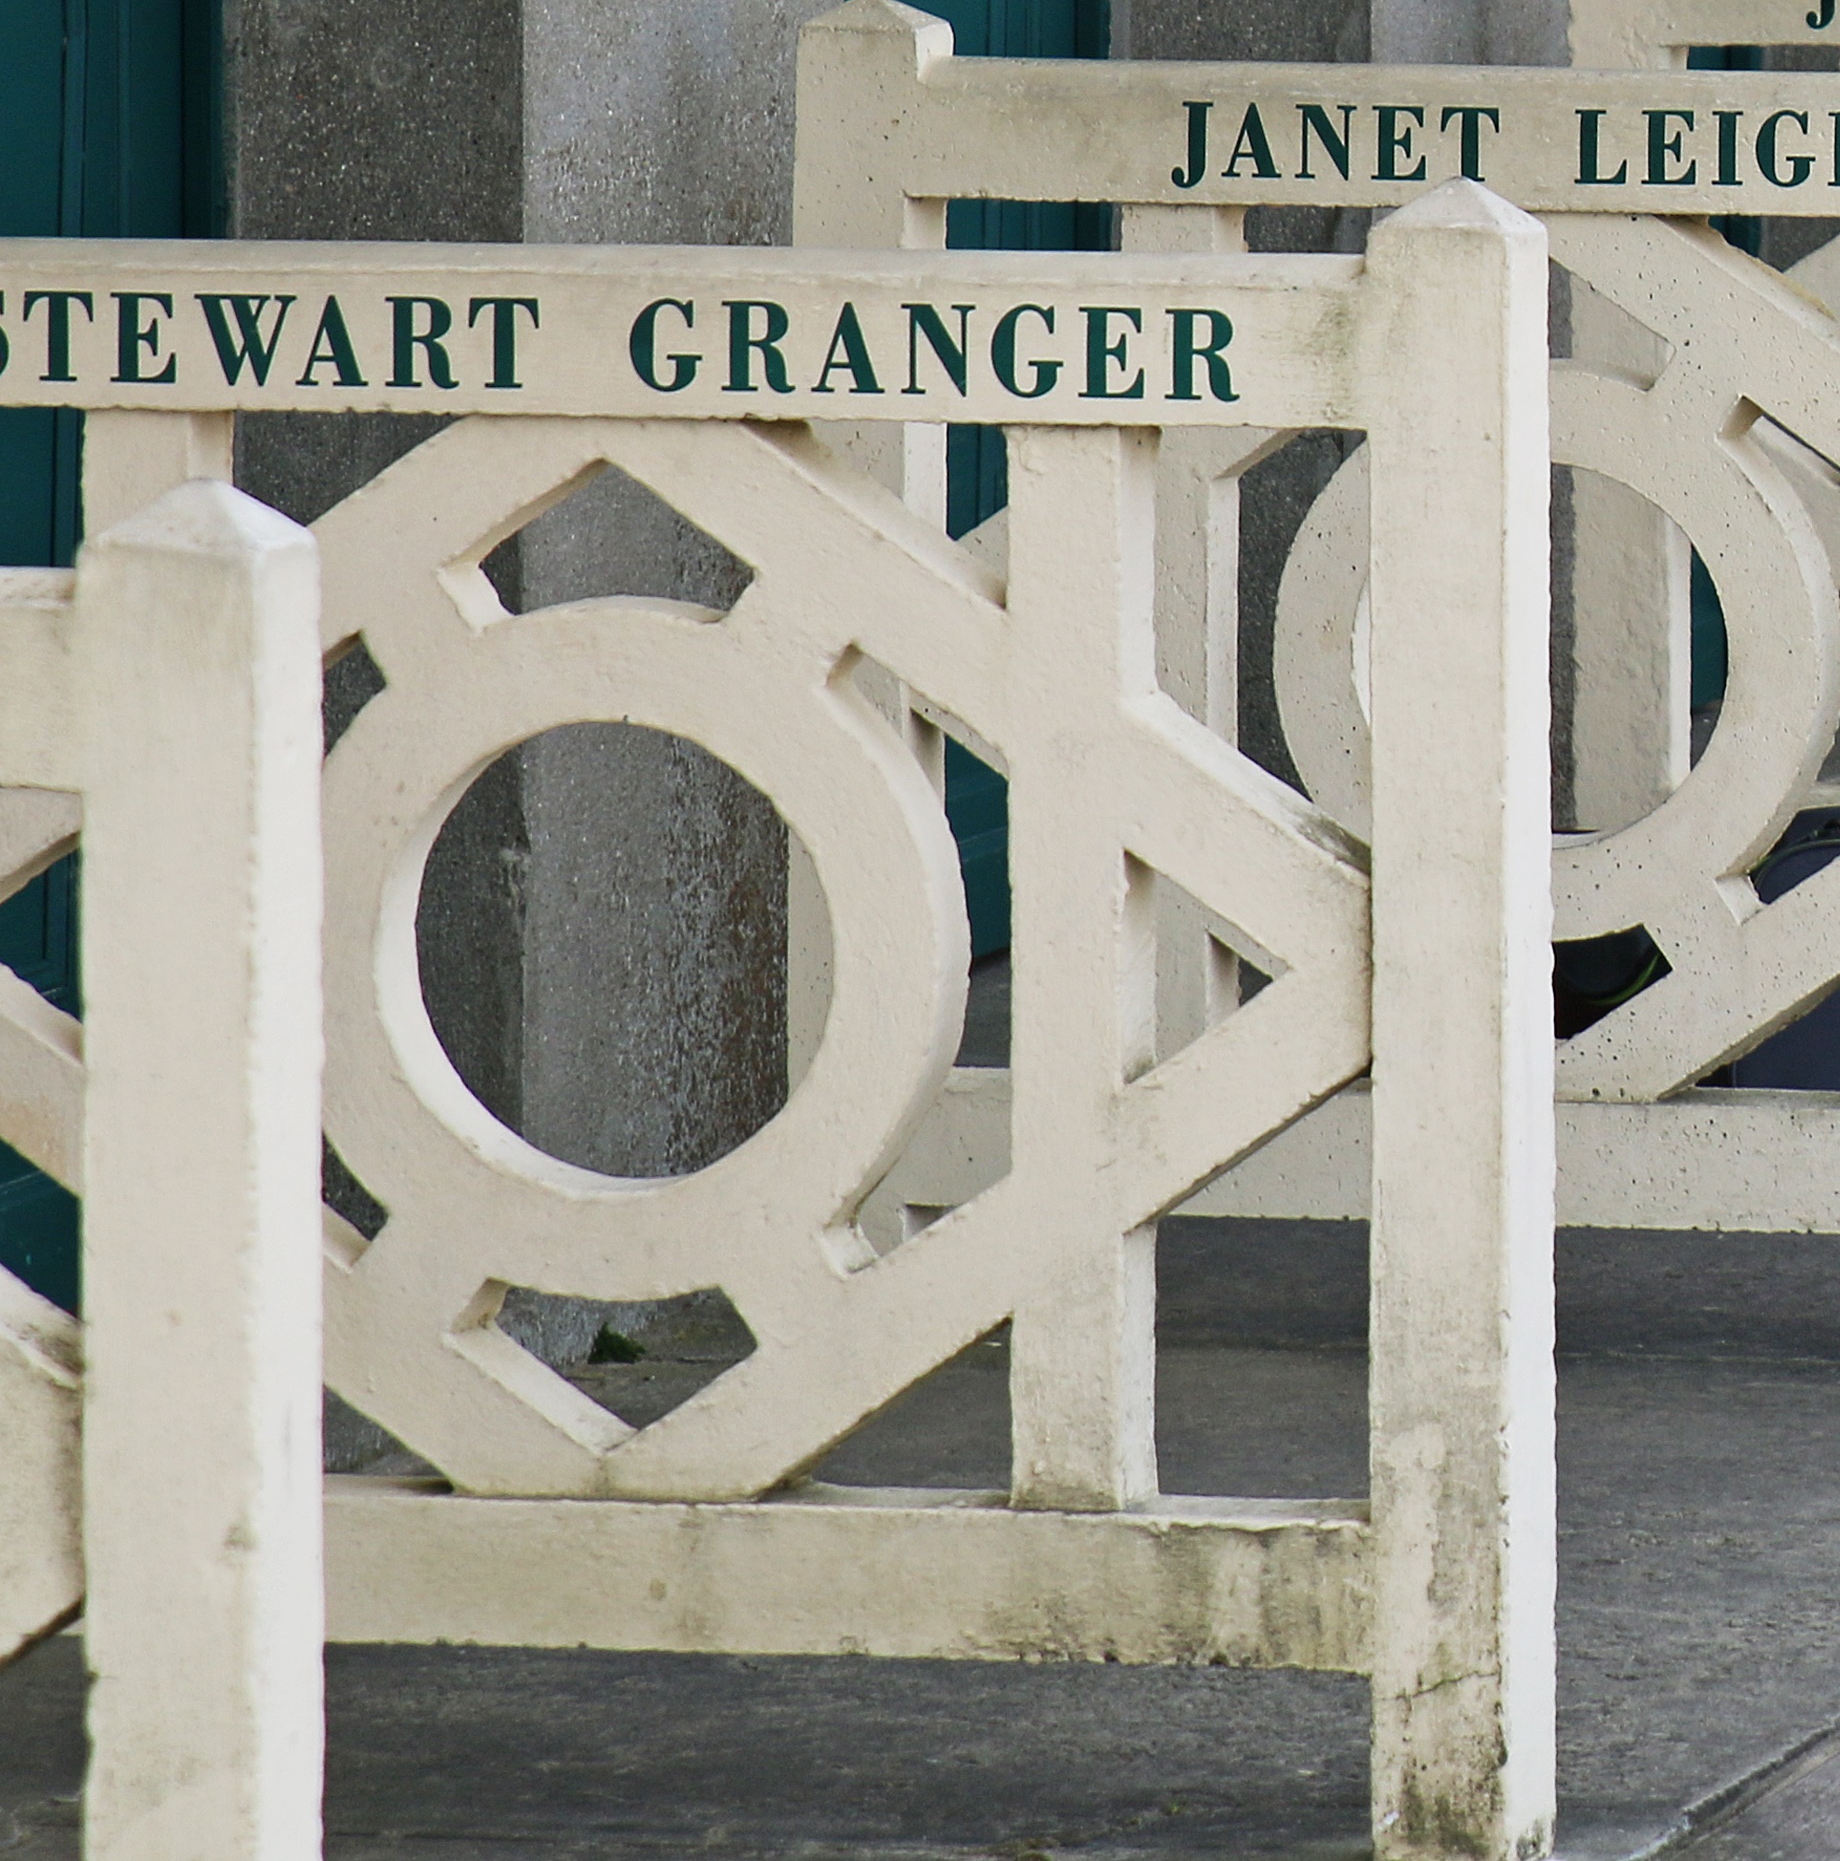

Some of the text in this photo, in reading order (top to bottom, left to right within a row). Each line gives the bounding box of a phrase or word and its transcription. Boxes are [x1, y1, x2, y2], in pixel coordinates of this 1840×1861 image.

[1170, 100, 1501, 190] JANET
[0, 290, 1241, 403] TEWART GRANGER
